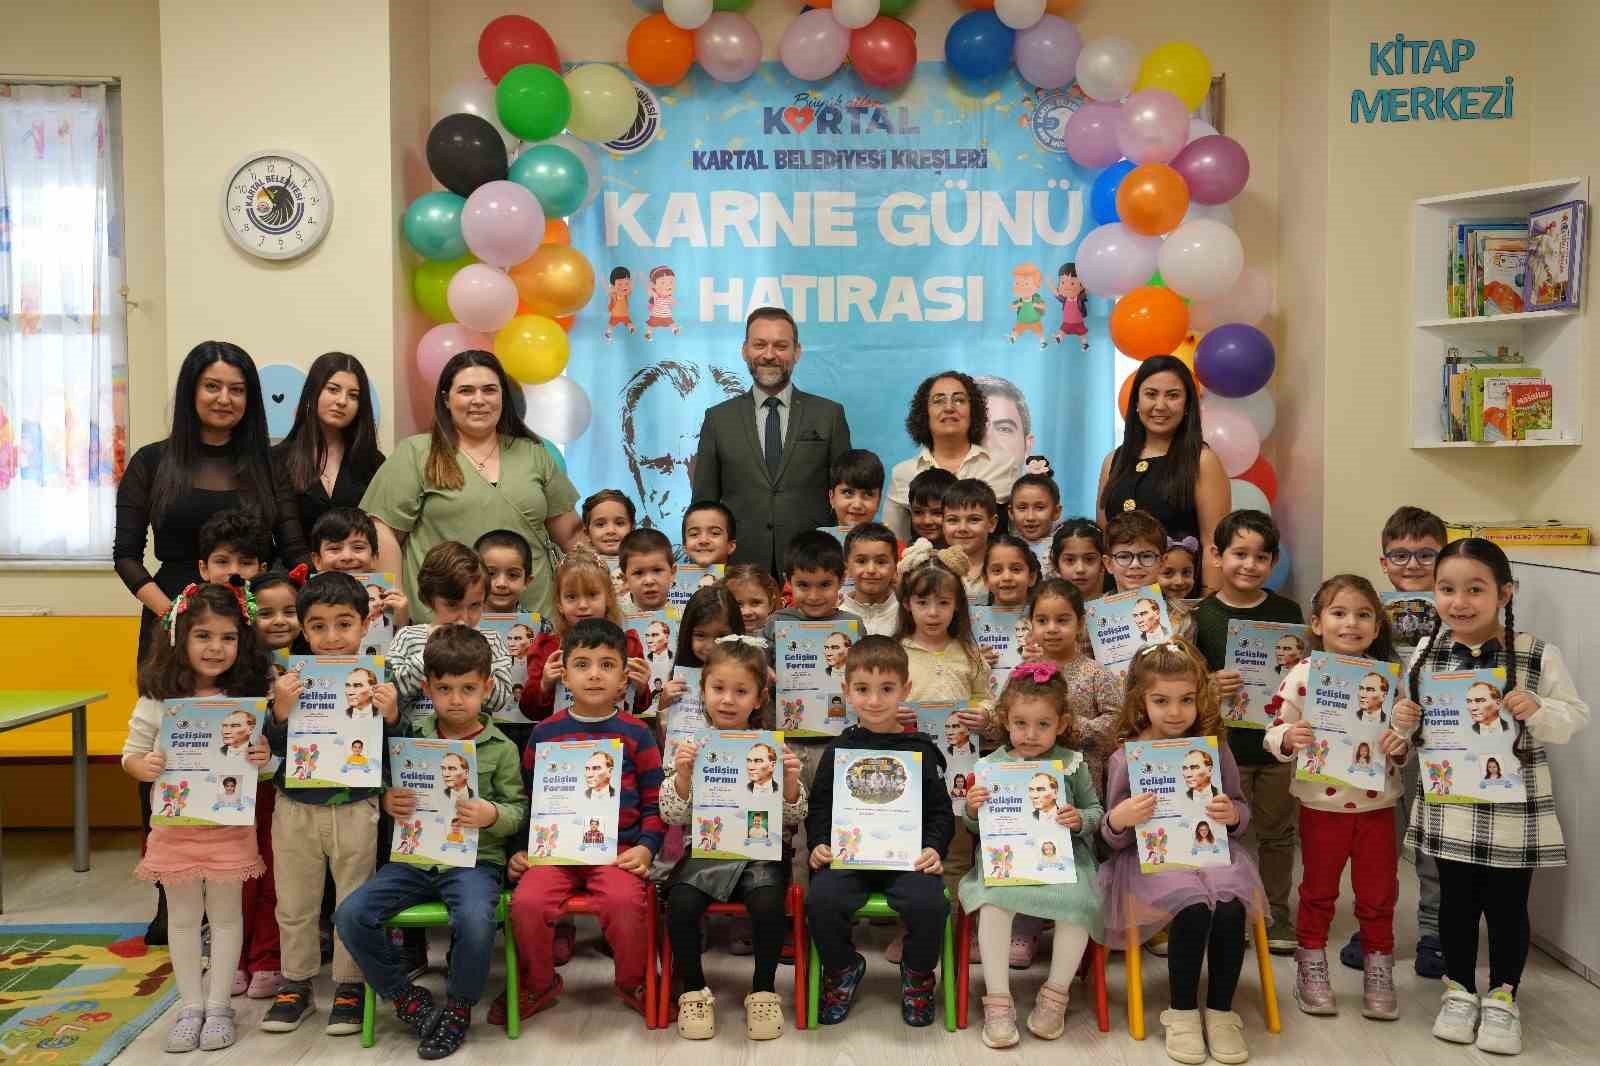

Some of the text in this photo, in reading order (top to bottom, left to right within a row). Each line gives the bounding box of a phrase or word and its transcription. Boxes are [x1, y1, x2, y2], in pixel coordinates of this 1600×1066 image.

[1369, 33, 1476, 76] KİTAP
[1350, 75, 1514, 124] MERKEZİ
[692, 149, 988, 175] KARTAL BELEDİYESİ KREŞLERİ
[603, 179, 1085, 248] KARNE GÜNÜ
[699, 275, 985, 323] HATIRASI
[300, 702, 335, 710] Formu
[171, 740, 209, 748] Formu
[704, 775, 737, 784] Formu
